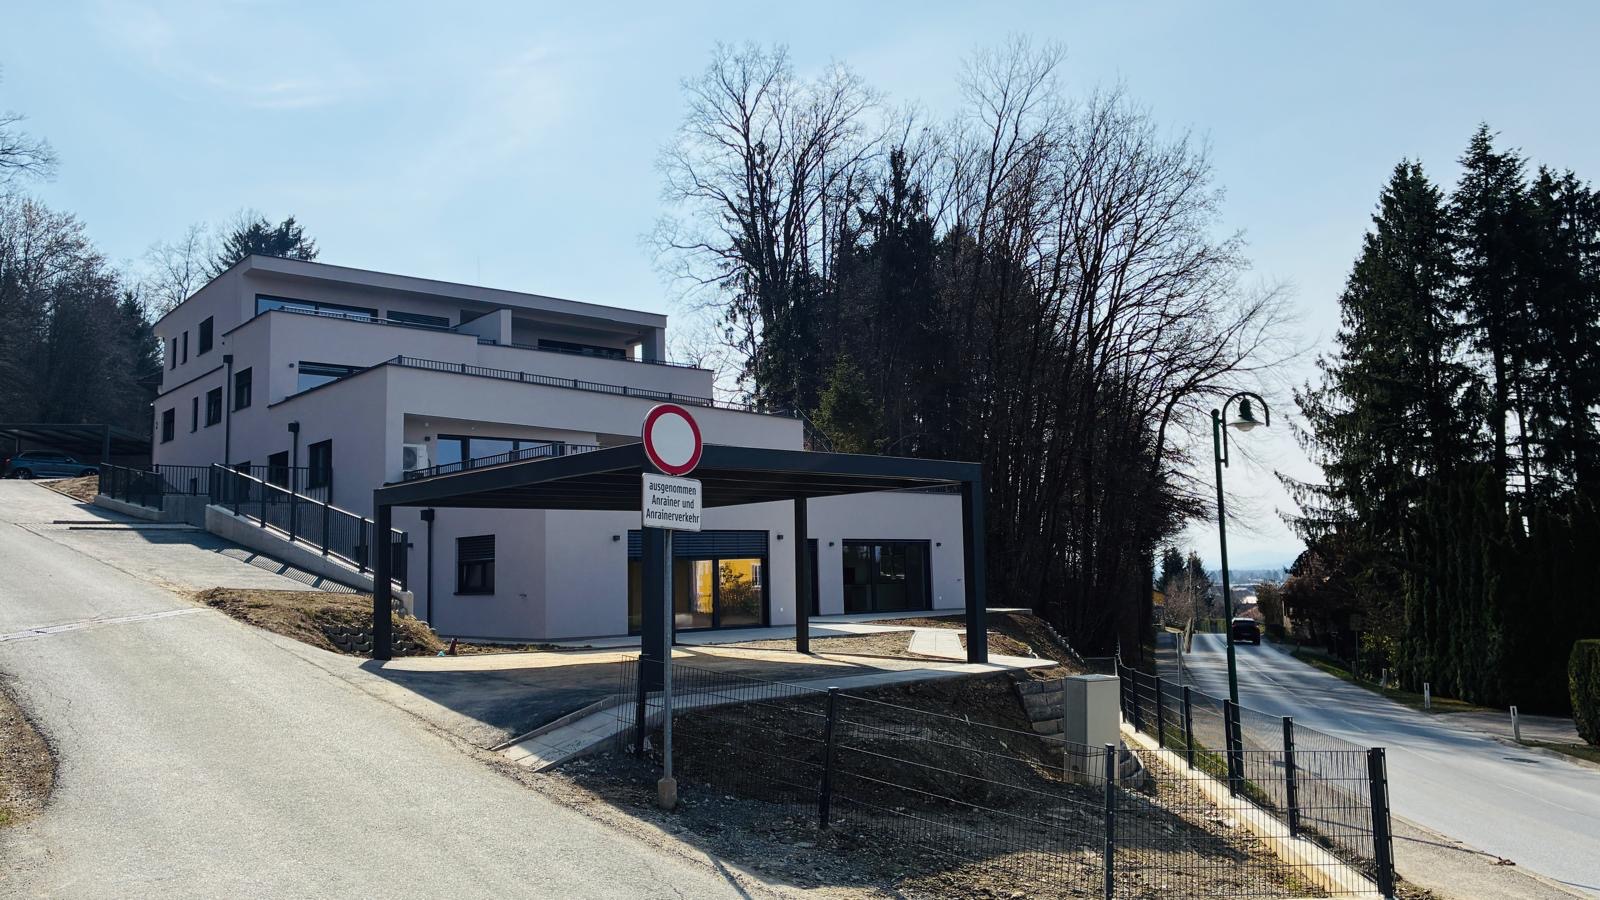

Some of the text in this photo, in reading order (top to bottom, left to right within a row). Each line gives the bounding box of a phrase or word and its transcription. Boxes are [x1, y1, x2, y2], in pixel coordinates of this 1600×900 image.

[649, 482, 697, 495] ausgenommen
[651, 494, 695, 509] Anrainer und
[646, 508, 700, 523] Anrainerverkehr
